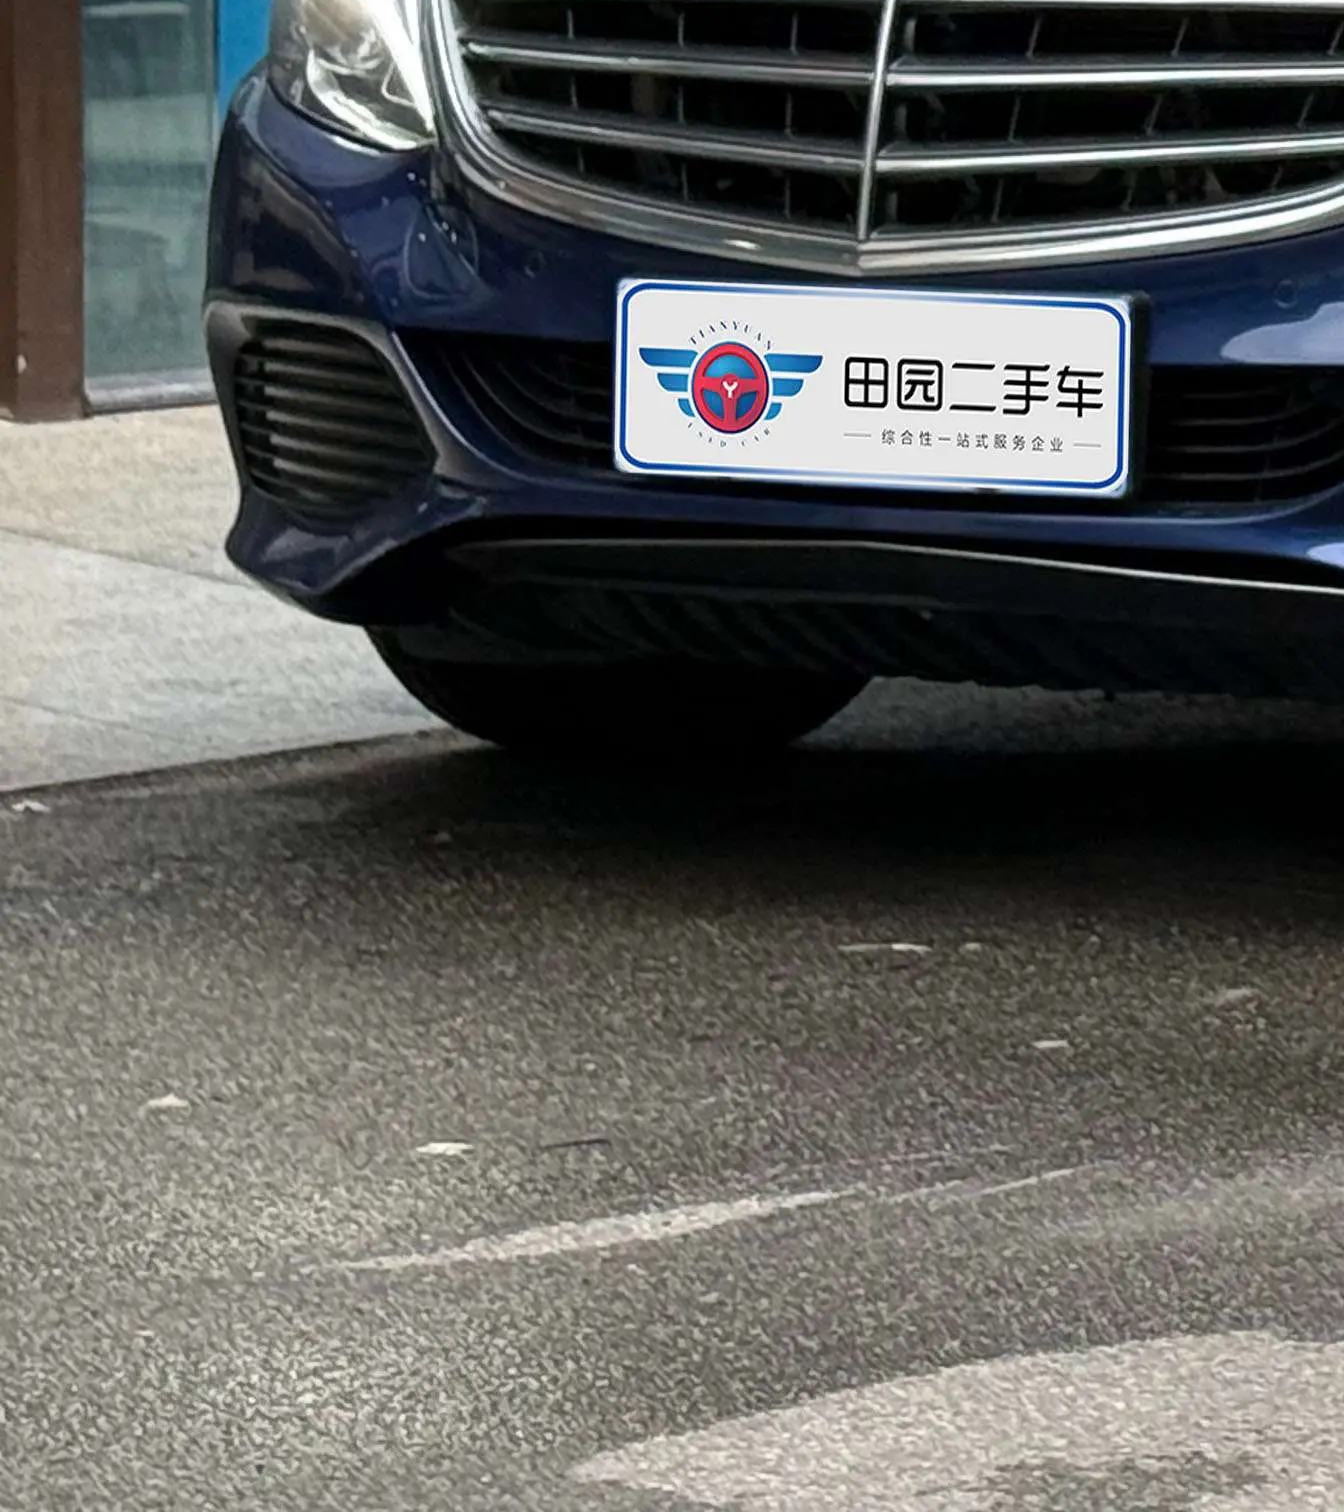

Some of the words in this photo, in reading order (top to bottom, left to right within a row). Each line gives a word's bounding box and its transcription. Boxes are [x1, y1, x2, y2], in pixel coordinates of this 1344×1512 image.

[844, 356, 1104, 418] 田园二手车
[881, 428, 1064, 453] 综合性一站式服务企业
